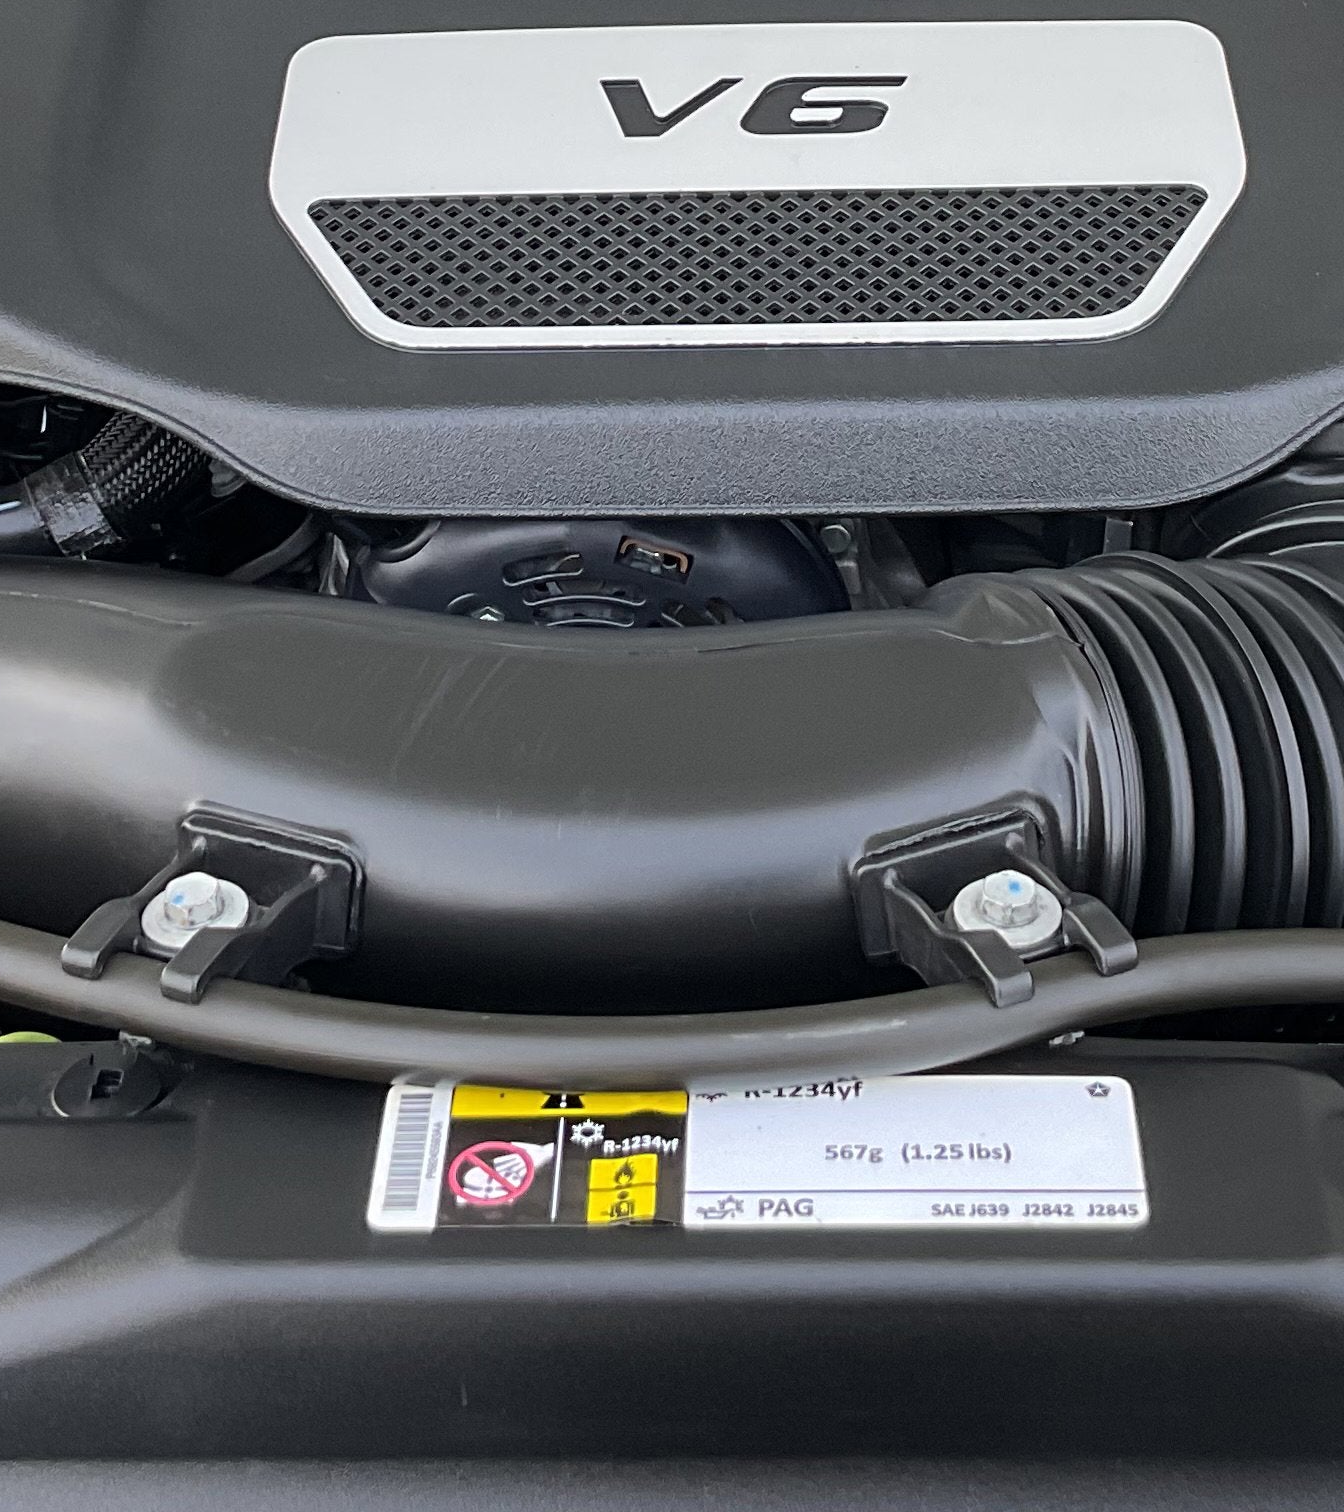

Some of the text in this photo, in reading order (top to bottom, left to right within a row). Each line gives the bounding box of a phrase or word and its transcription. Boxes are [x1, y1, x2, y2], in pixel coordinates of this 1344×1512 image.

[599, 75, 909, 138] V6
[603, 1135, 679, 1155] R-1234yf
[825, 1142, 1012, 1163] 567g (1.25 lbs)
[758, 1198, 814, 1217] PAG
[931, 1203, 1139, 1217] SAE J639 J2842 J2845
